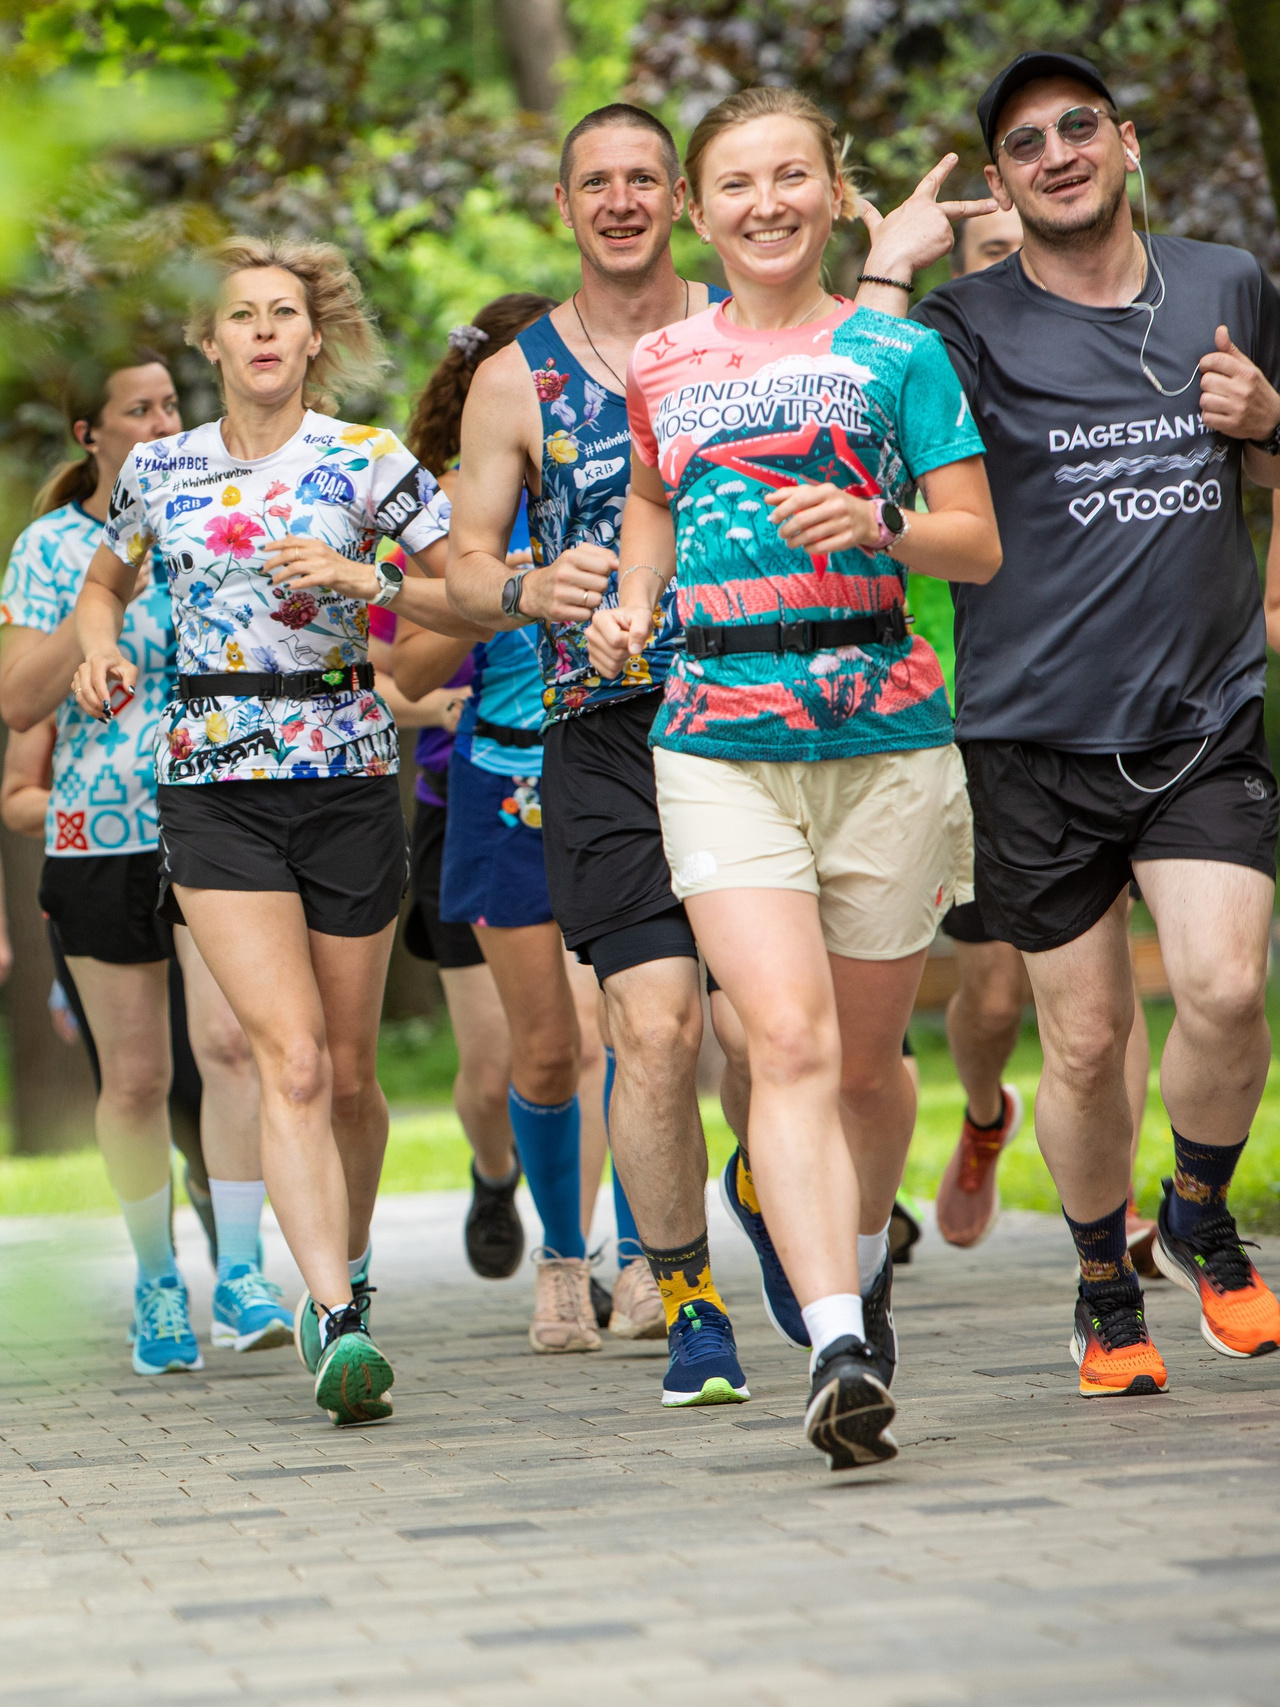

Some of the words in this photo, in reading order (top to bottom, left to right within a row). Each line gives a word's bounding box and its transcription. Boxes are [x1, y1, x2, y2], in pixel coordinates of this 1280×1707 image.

[1048, 413, 1195, 453] DAGESTAN
[585, 463, 613, 480] KRB
[173, 498, 202, 513] KRB
